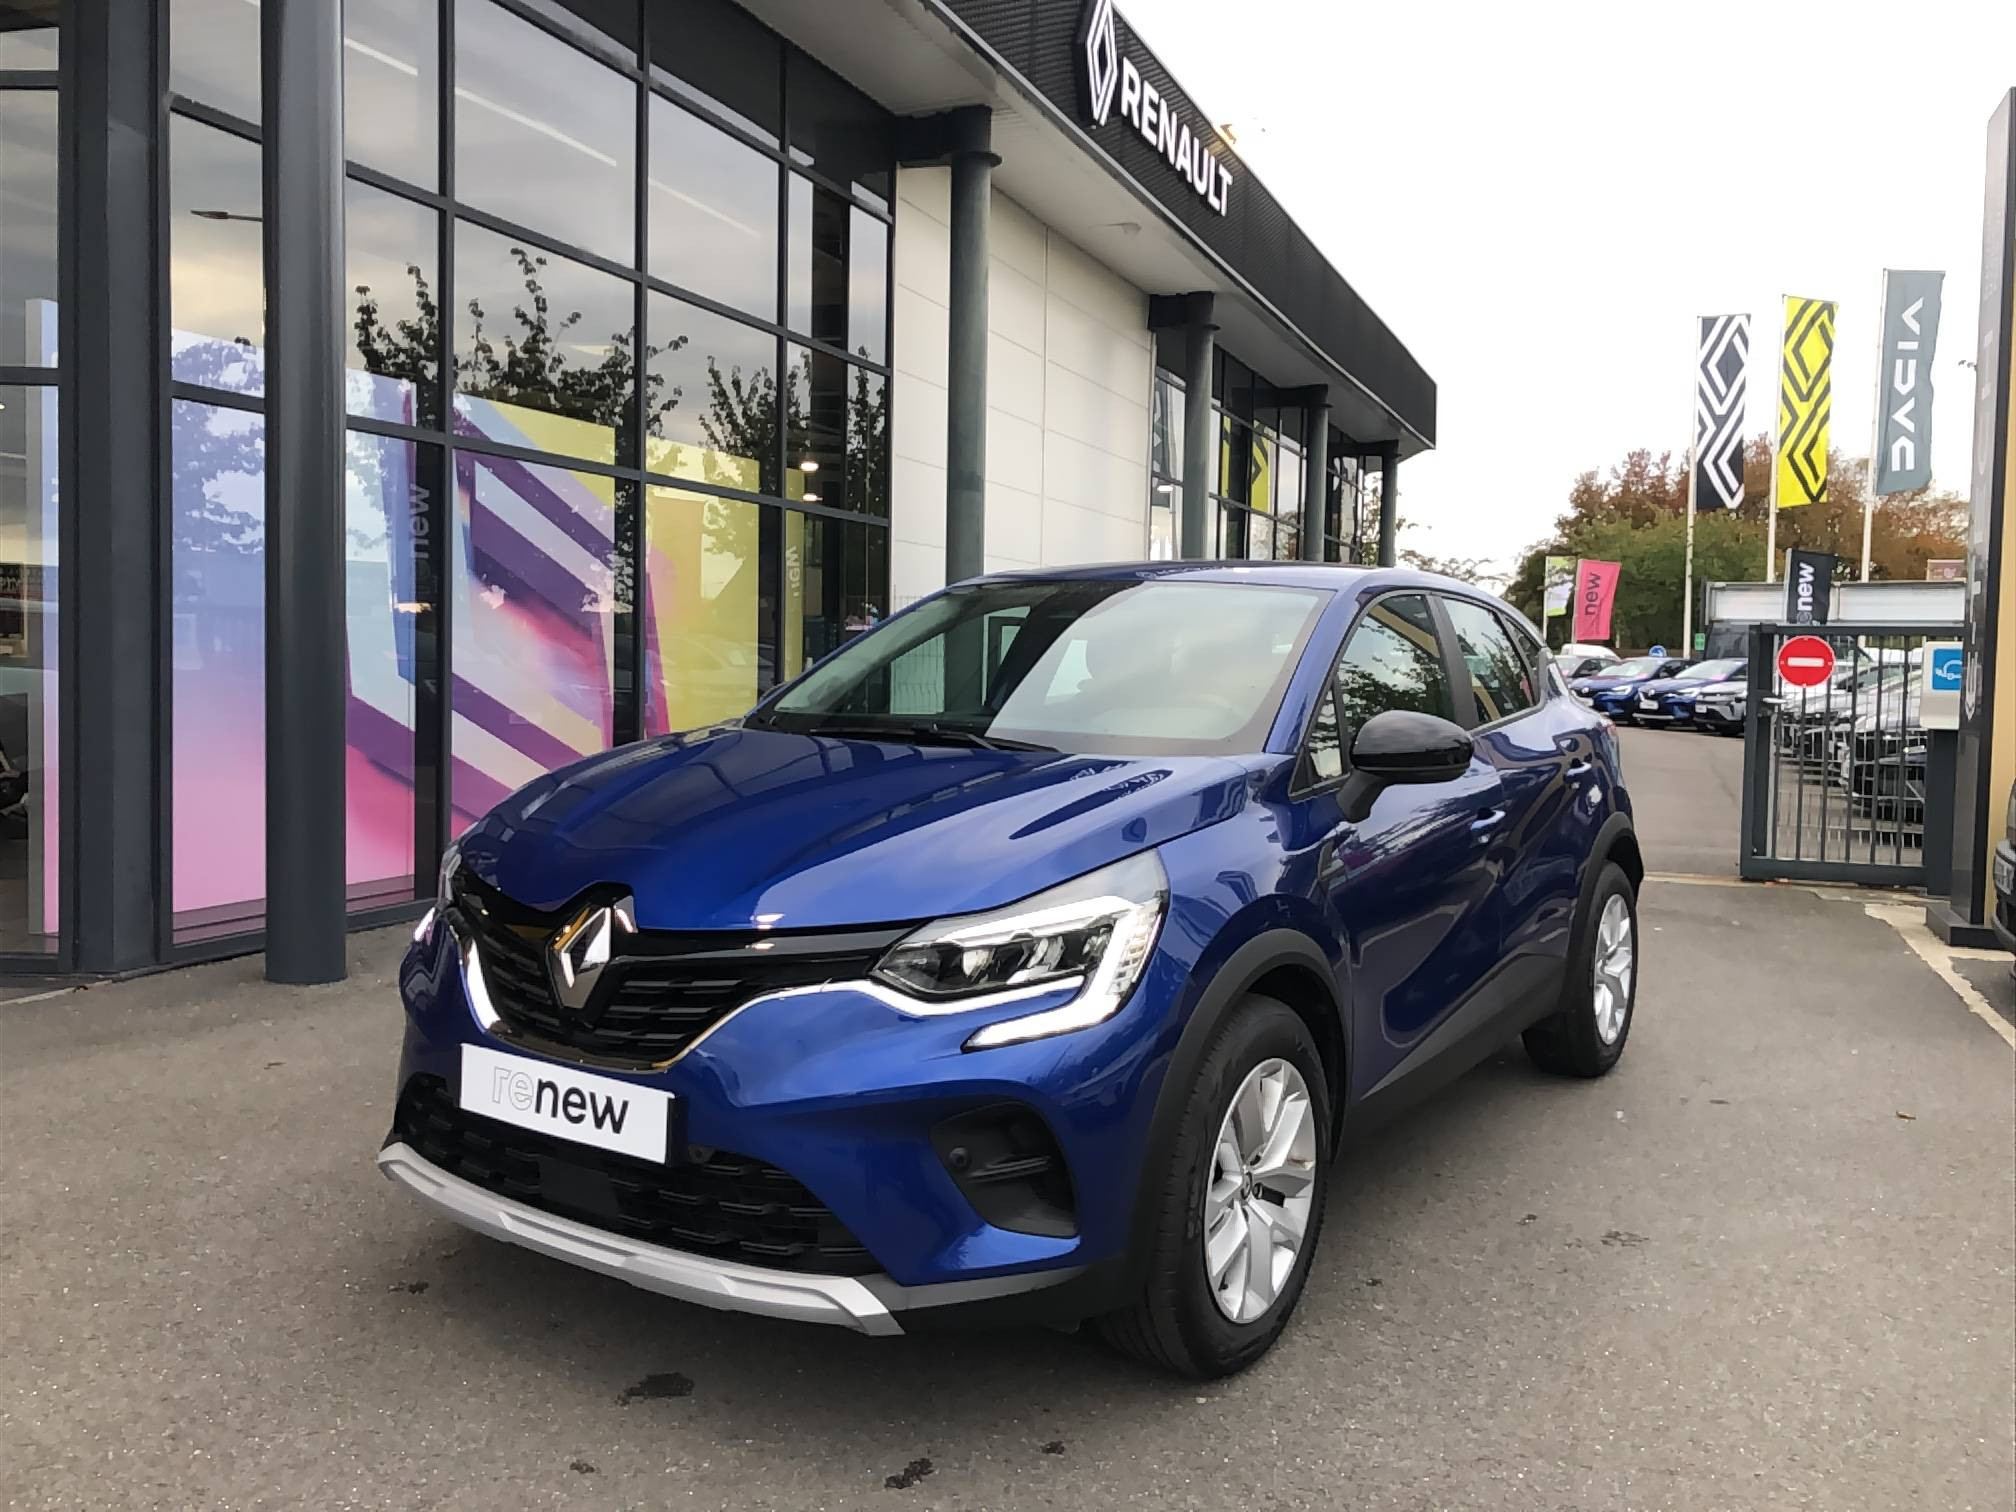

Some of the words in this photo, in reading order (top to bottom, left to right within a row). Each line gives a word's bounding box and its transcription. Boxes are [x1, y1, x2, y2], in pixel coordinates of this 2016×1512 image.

[1121, 57, 1233, 217] RENAULT
[1891, 297, 1925, 472] DACIA
[492, 1065, 630, 1135] renew
